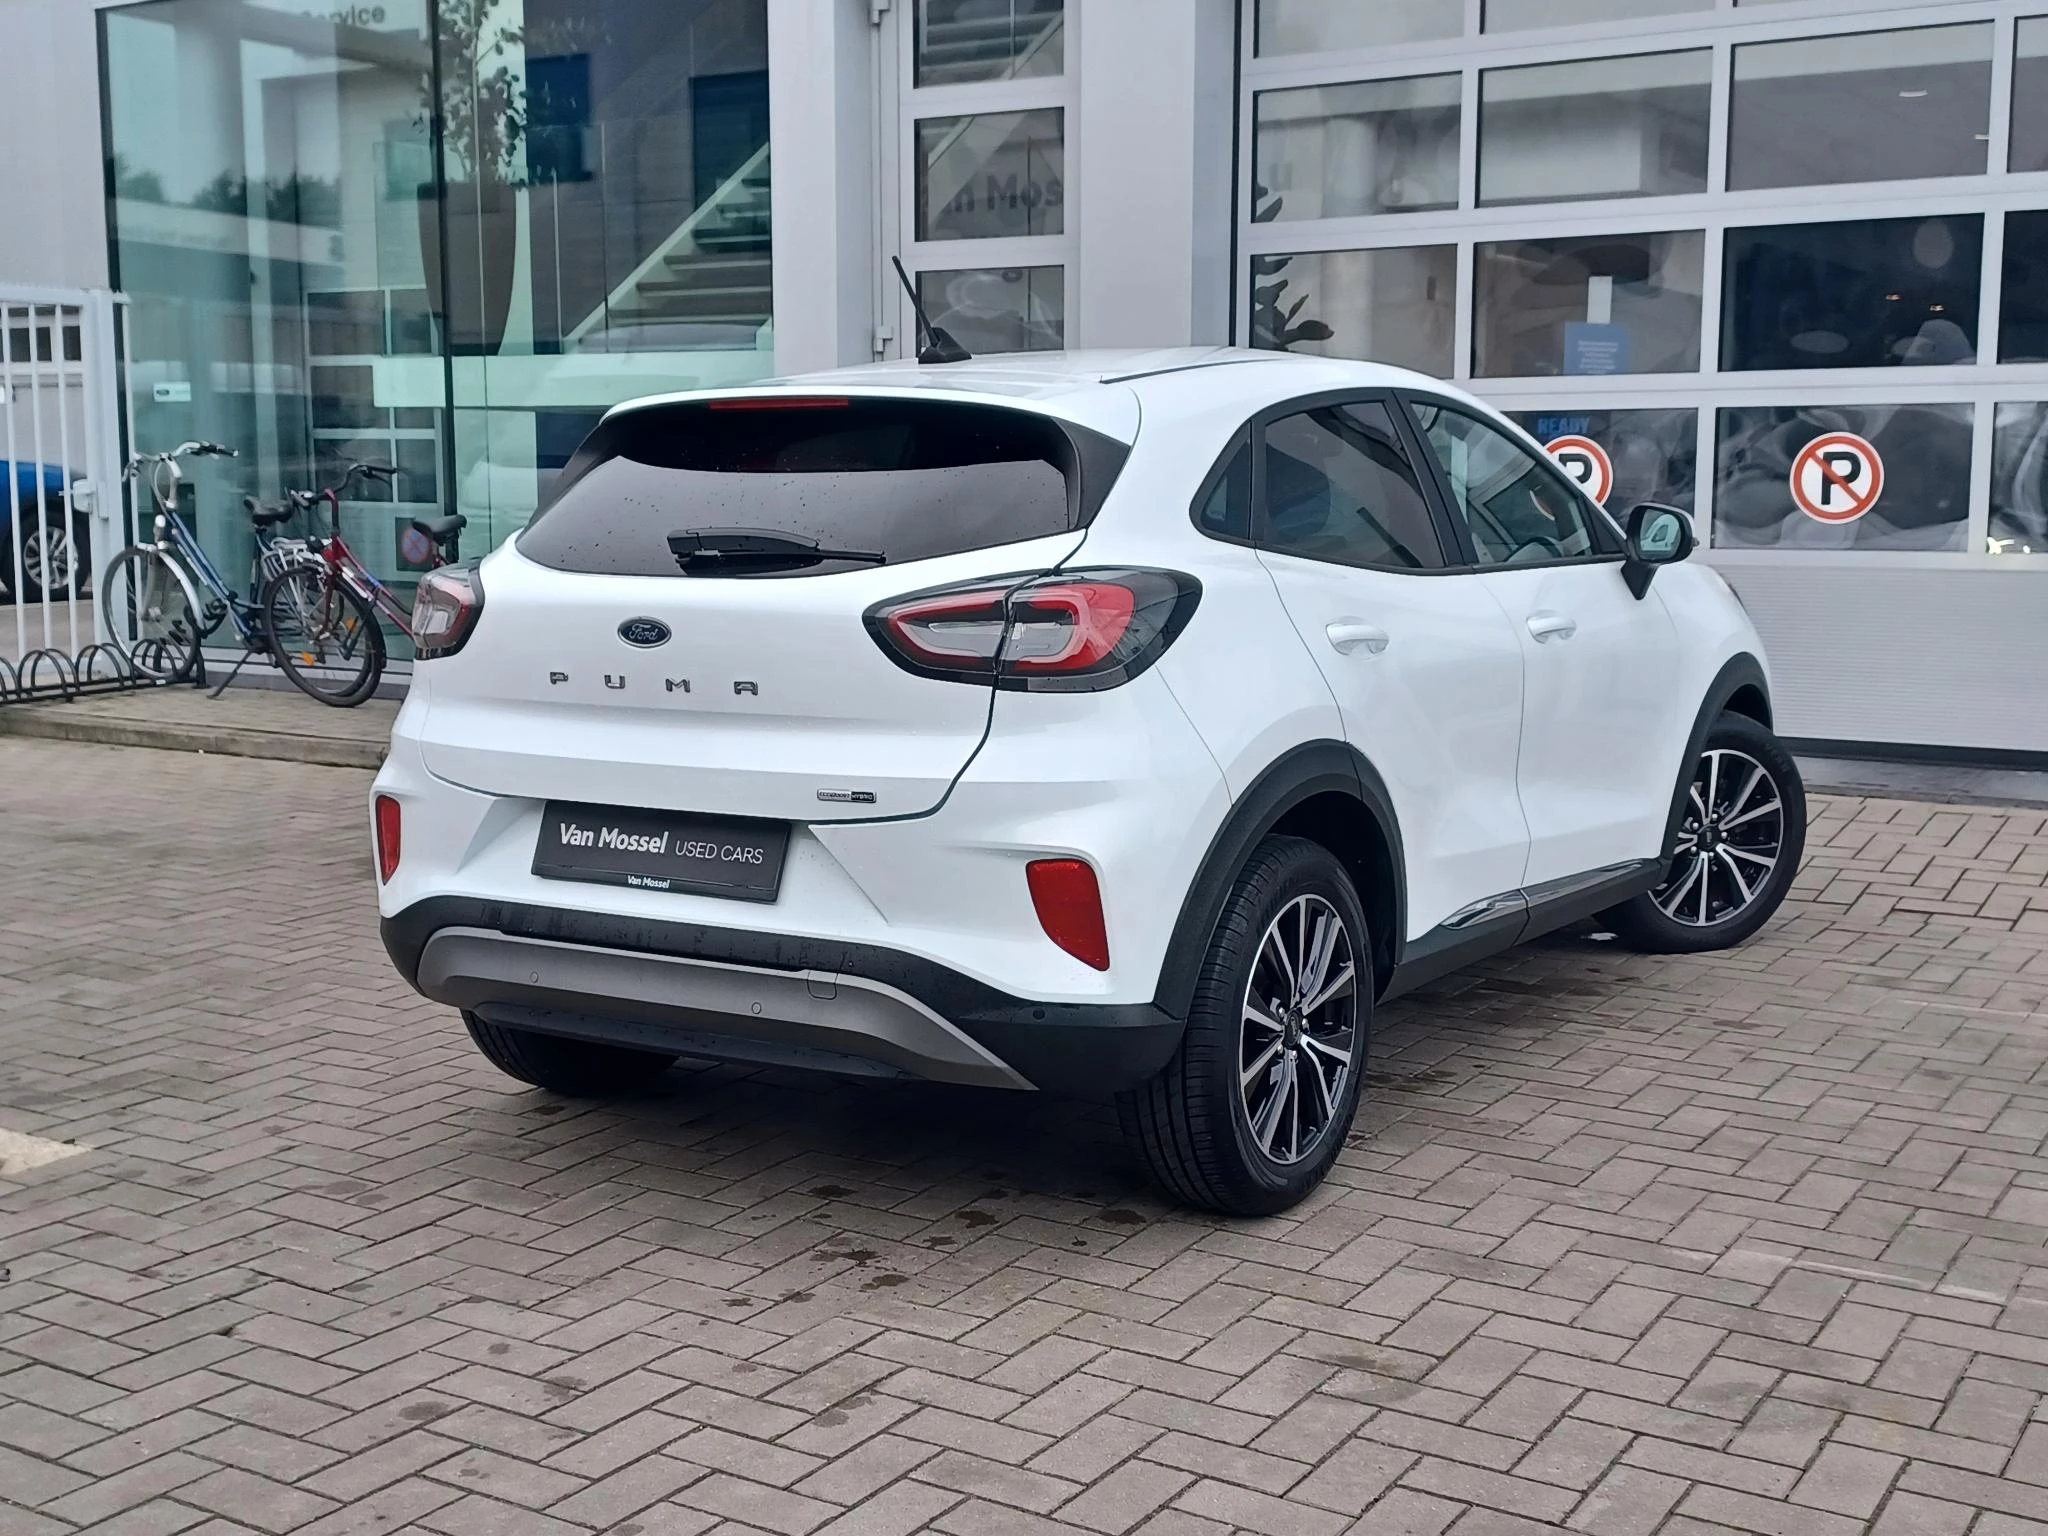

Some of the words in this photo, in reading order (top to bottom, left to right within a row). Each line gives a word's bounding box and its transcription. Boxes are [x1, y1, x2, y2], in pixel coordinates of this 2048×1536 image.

[1537, 416, 1590, 434] READY
[1820, 451, 1862, 505] P
[628, 622, 659, 642] Ford
[549, 671, 759, 696] PUMA
[559, 822, 594, 848] Van
[598, 826, 669, 854] Mossel
[675, 840, 717, 859] USED
[720, 845, 764, 865] CARS
[627, 875, 642, 886] Van
[643, 877, 671, 889] Mossel
